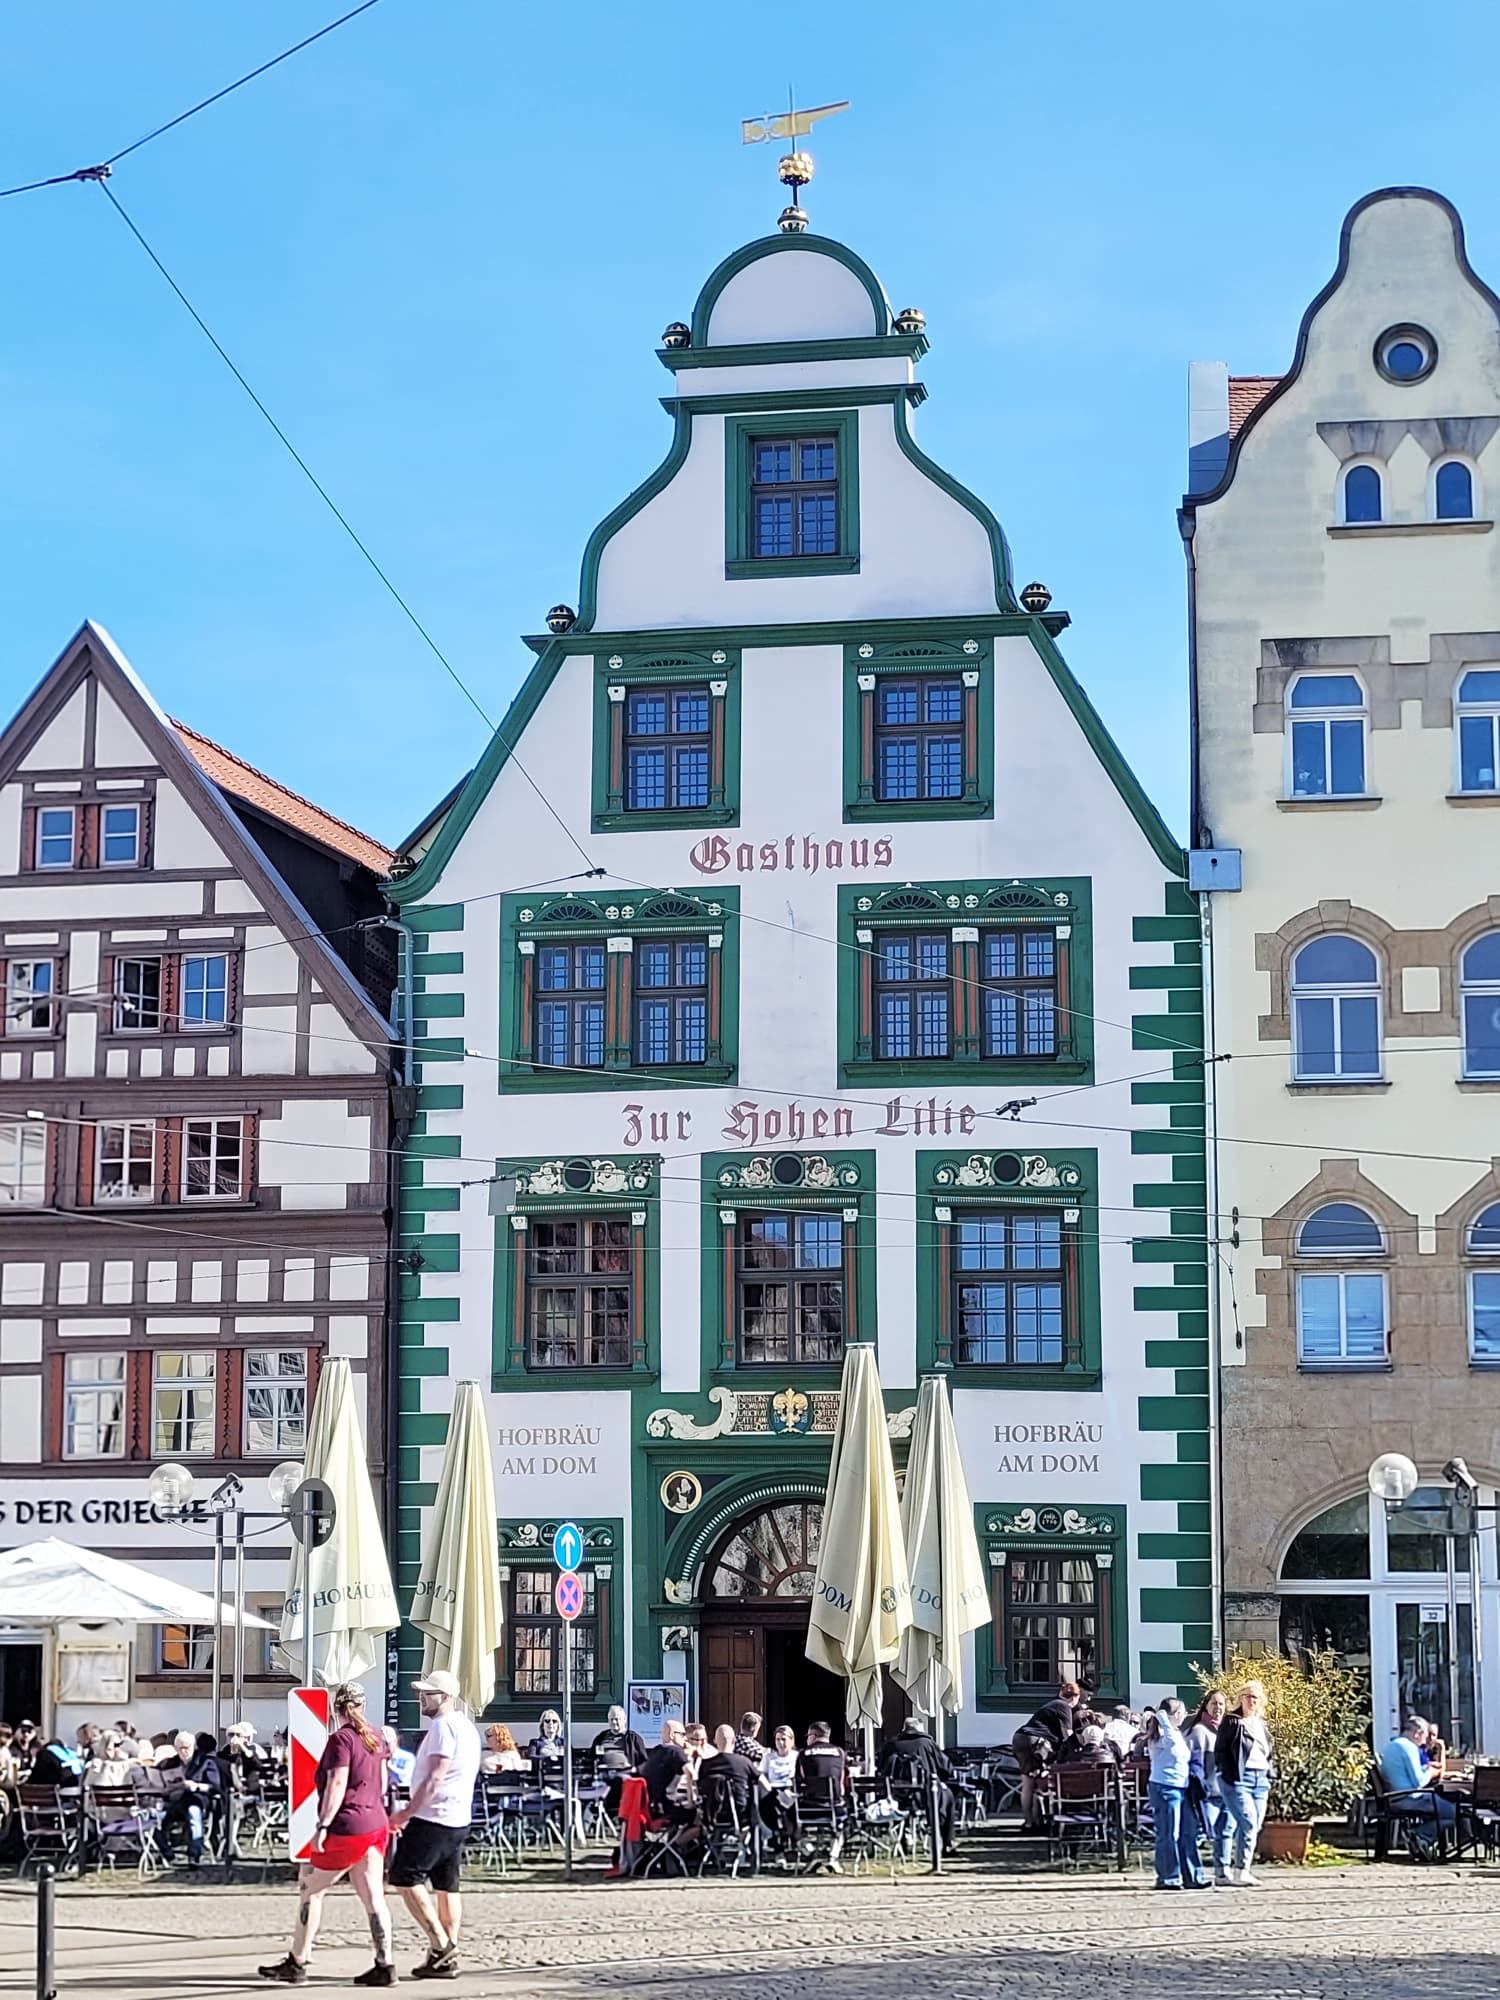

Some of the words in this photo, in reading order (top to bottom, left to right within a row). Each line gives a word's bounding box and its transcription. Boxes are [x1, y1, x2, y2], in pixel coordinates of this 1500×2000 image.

[689, 832, 894, 876] Gasthaus
[621, 1102, 692, 1147] Zur
[721, 1098, 854, 1148] Hohen
[874, 1094, 977, 1138] Lilie
[498, 1423, 601, 1446] HOFBRÄU
[992, 1420, 1104, 1443] HOFBRÄU
[502, 1457, 536, 1475] AM
[542, 1456, 597, 1475] DOM
[997, 1454, 1035, 1473] AM
[1041, 1453, 1100, 1473] DOM
[14, 1500, 75, 1524] DER
